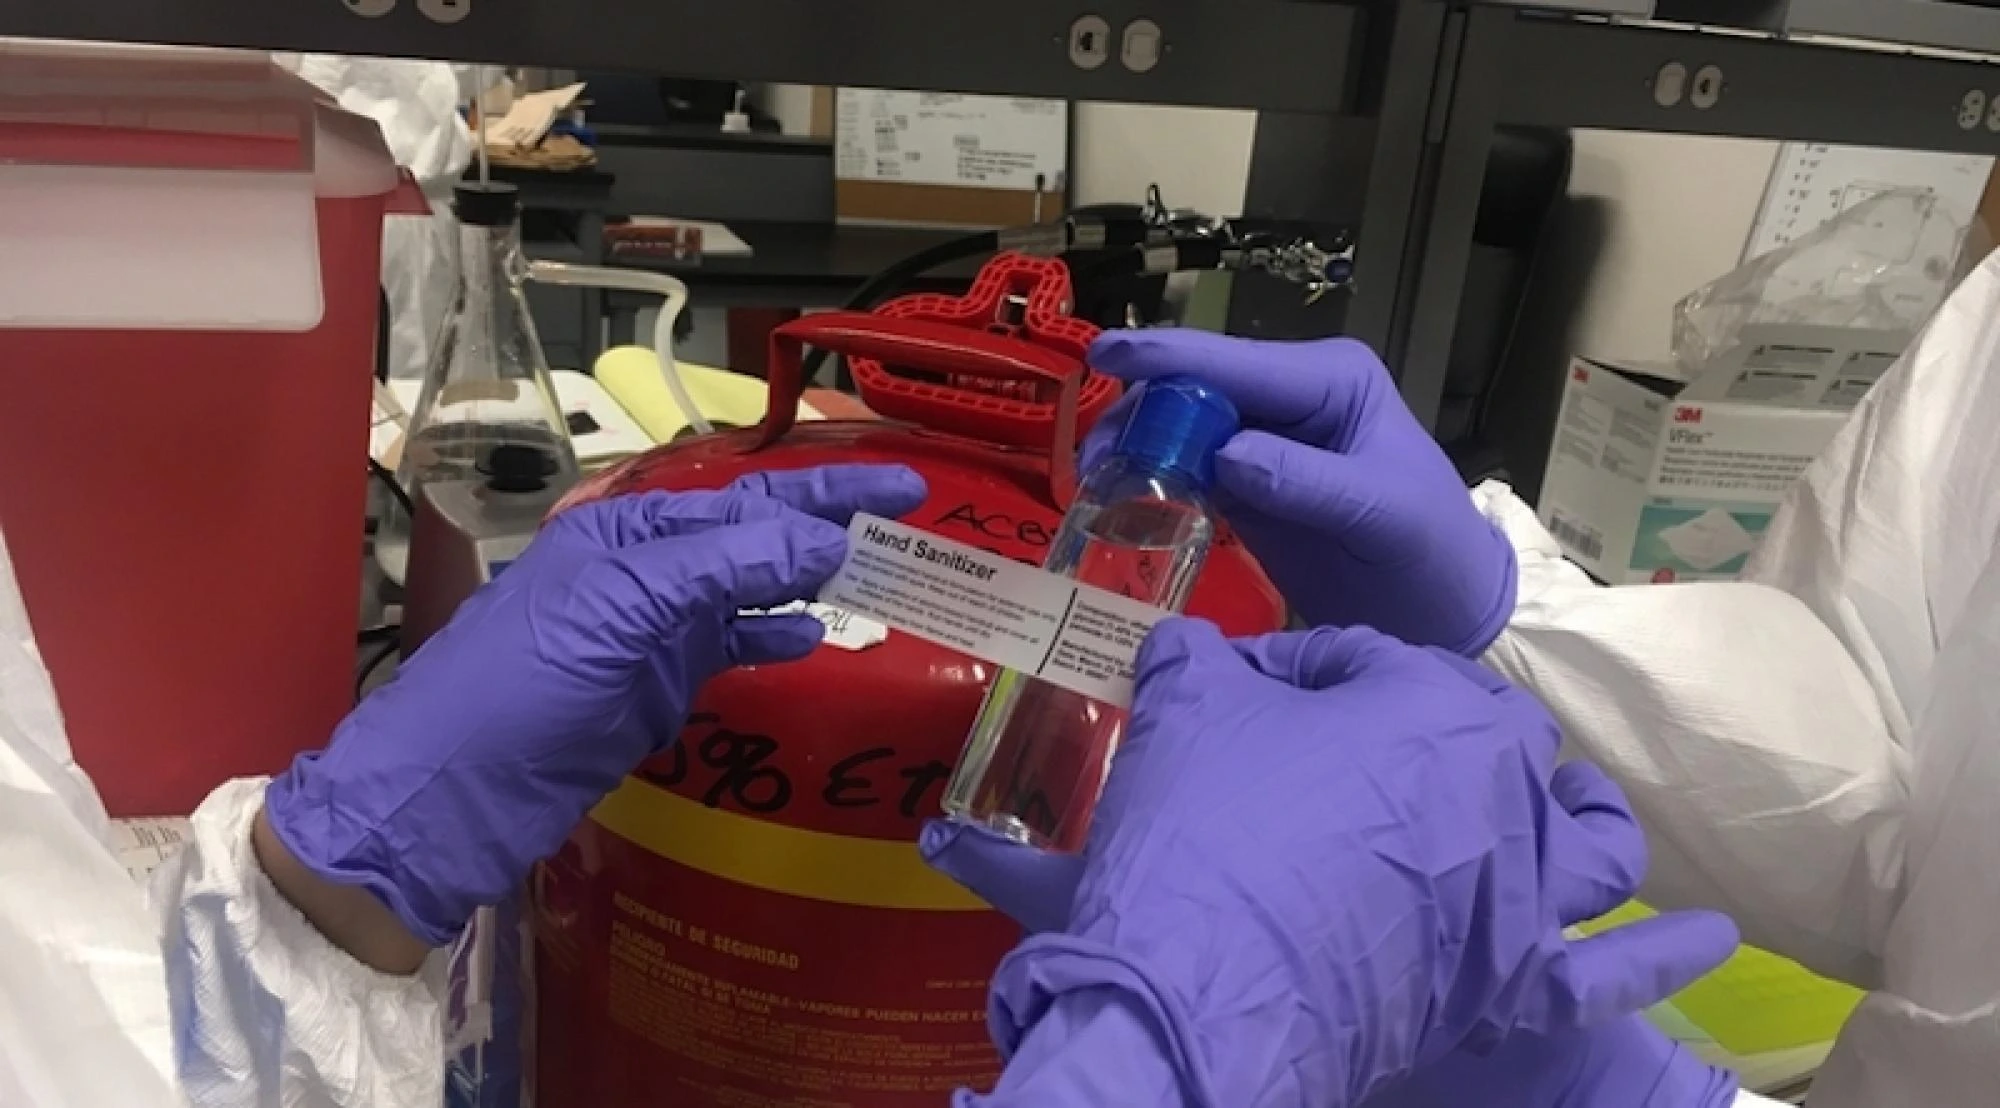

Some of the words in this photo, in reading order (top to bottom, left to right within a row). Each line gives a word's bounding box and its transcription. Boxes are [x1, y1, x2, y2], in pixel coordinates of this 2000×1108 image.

[1674, 407, 1703, 423] 3M
[863, 522, 912, 554] Hand
[914, 539, 999, 582] Sanitizer
[688, 924, 706, 946] DE
[713, 933, 799, 970] SEGURIDAD
[865, 1007, 918, 1022] PUEDEN
[922, 1009, 968, 1023] HACER
